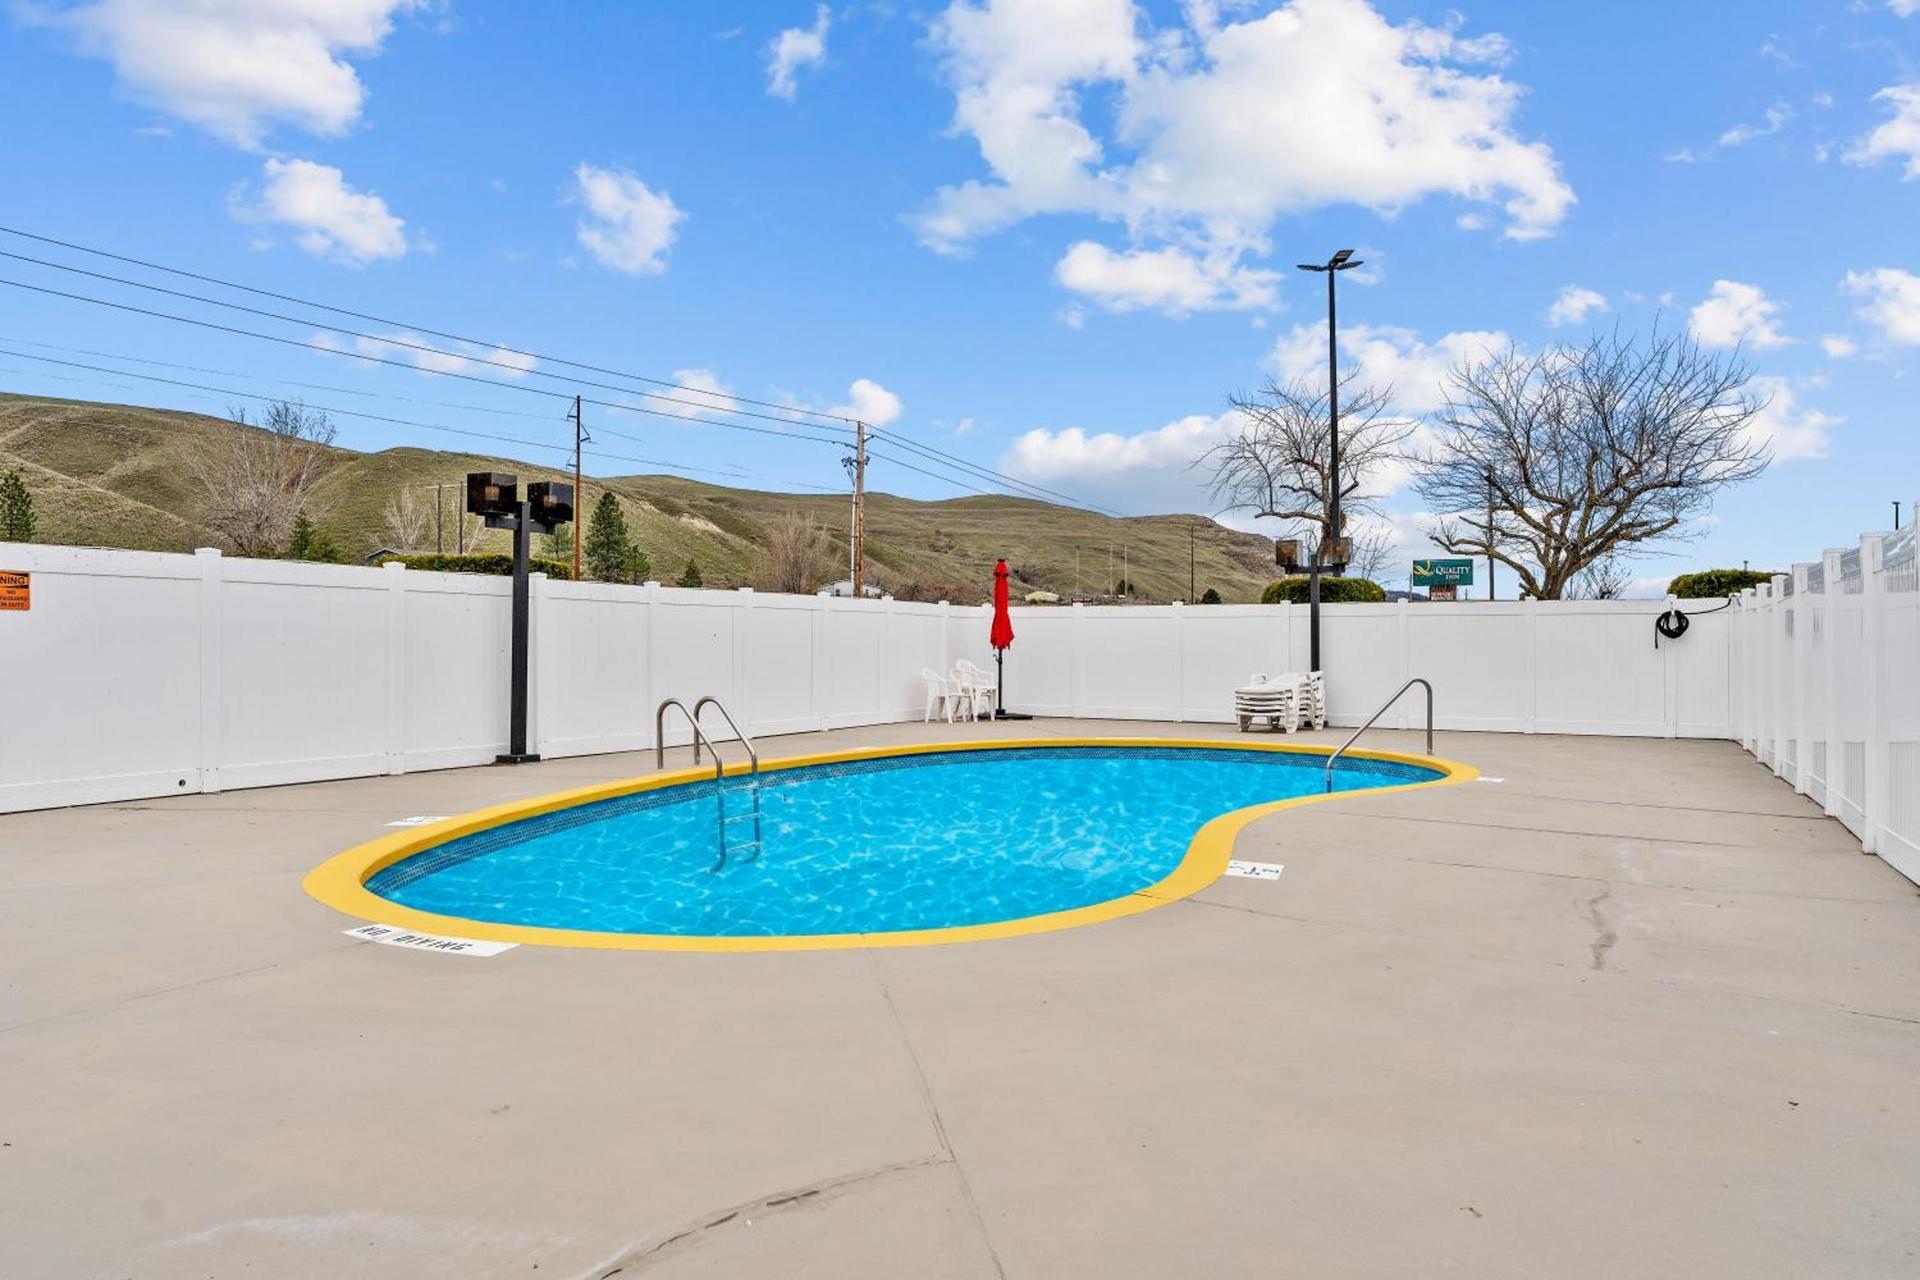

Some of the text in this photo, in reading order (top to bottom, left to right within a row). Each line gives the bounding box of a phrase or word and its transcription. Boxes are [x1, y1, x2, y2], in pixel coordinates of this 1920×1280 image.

[1435, 565, 1470, 576] QUALITY
[356, 926, 473, 951] NO DIVING
